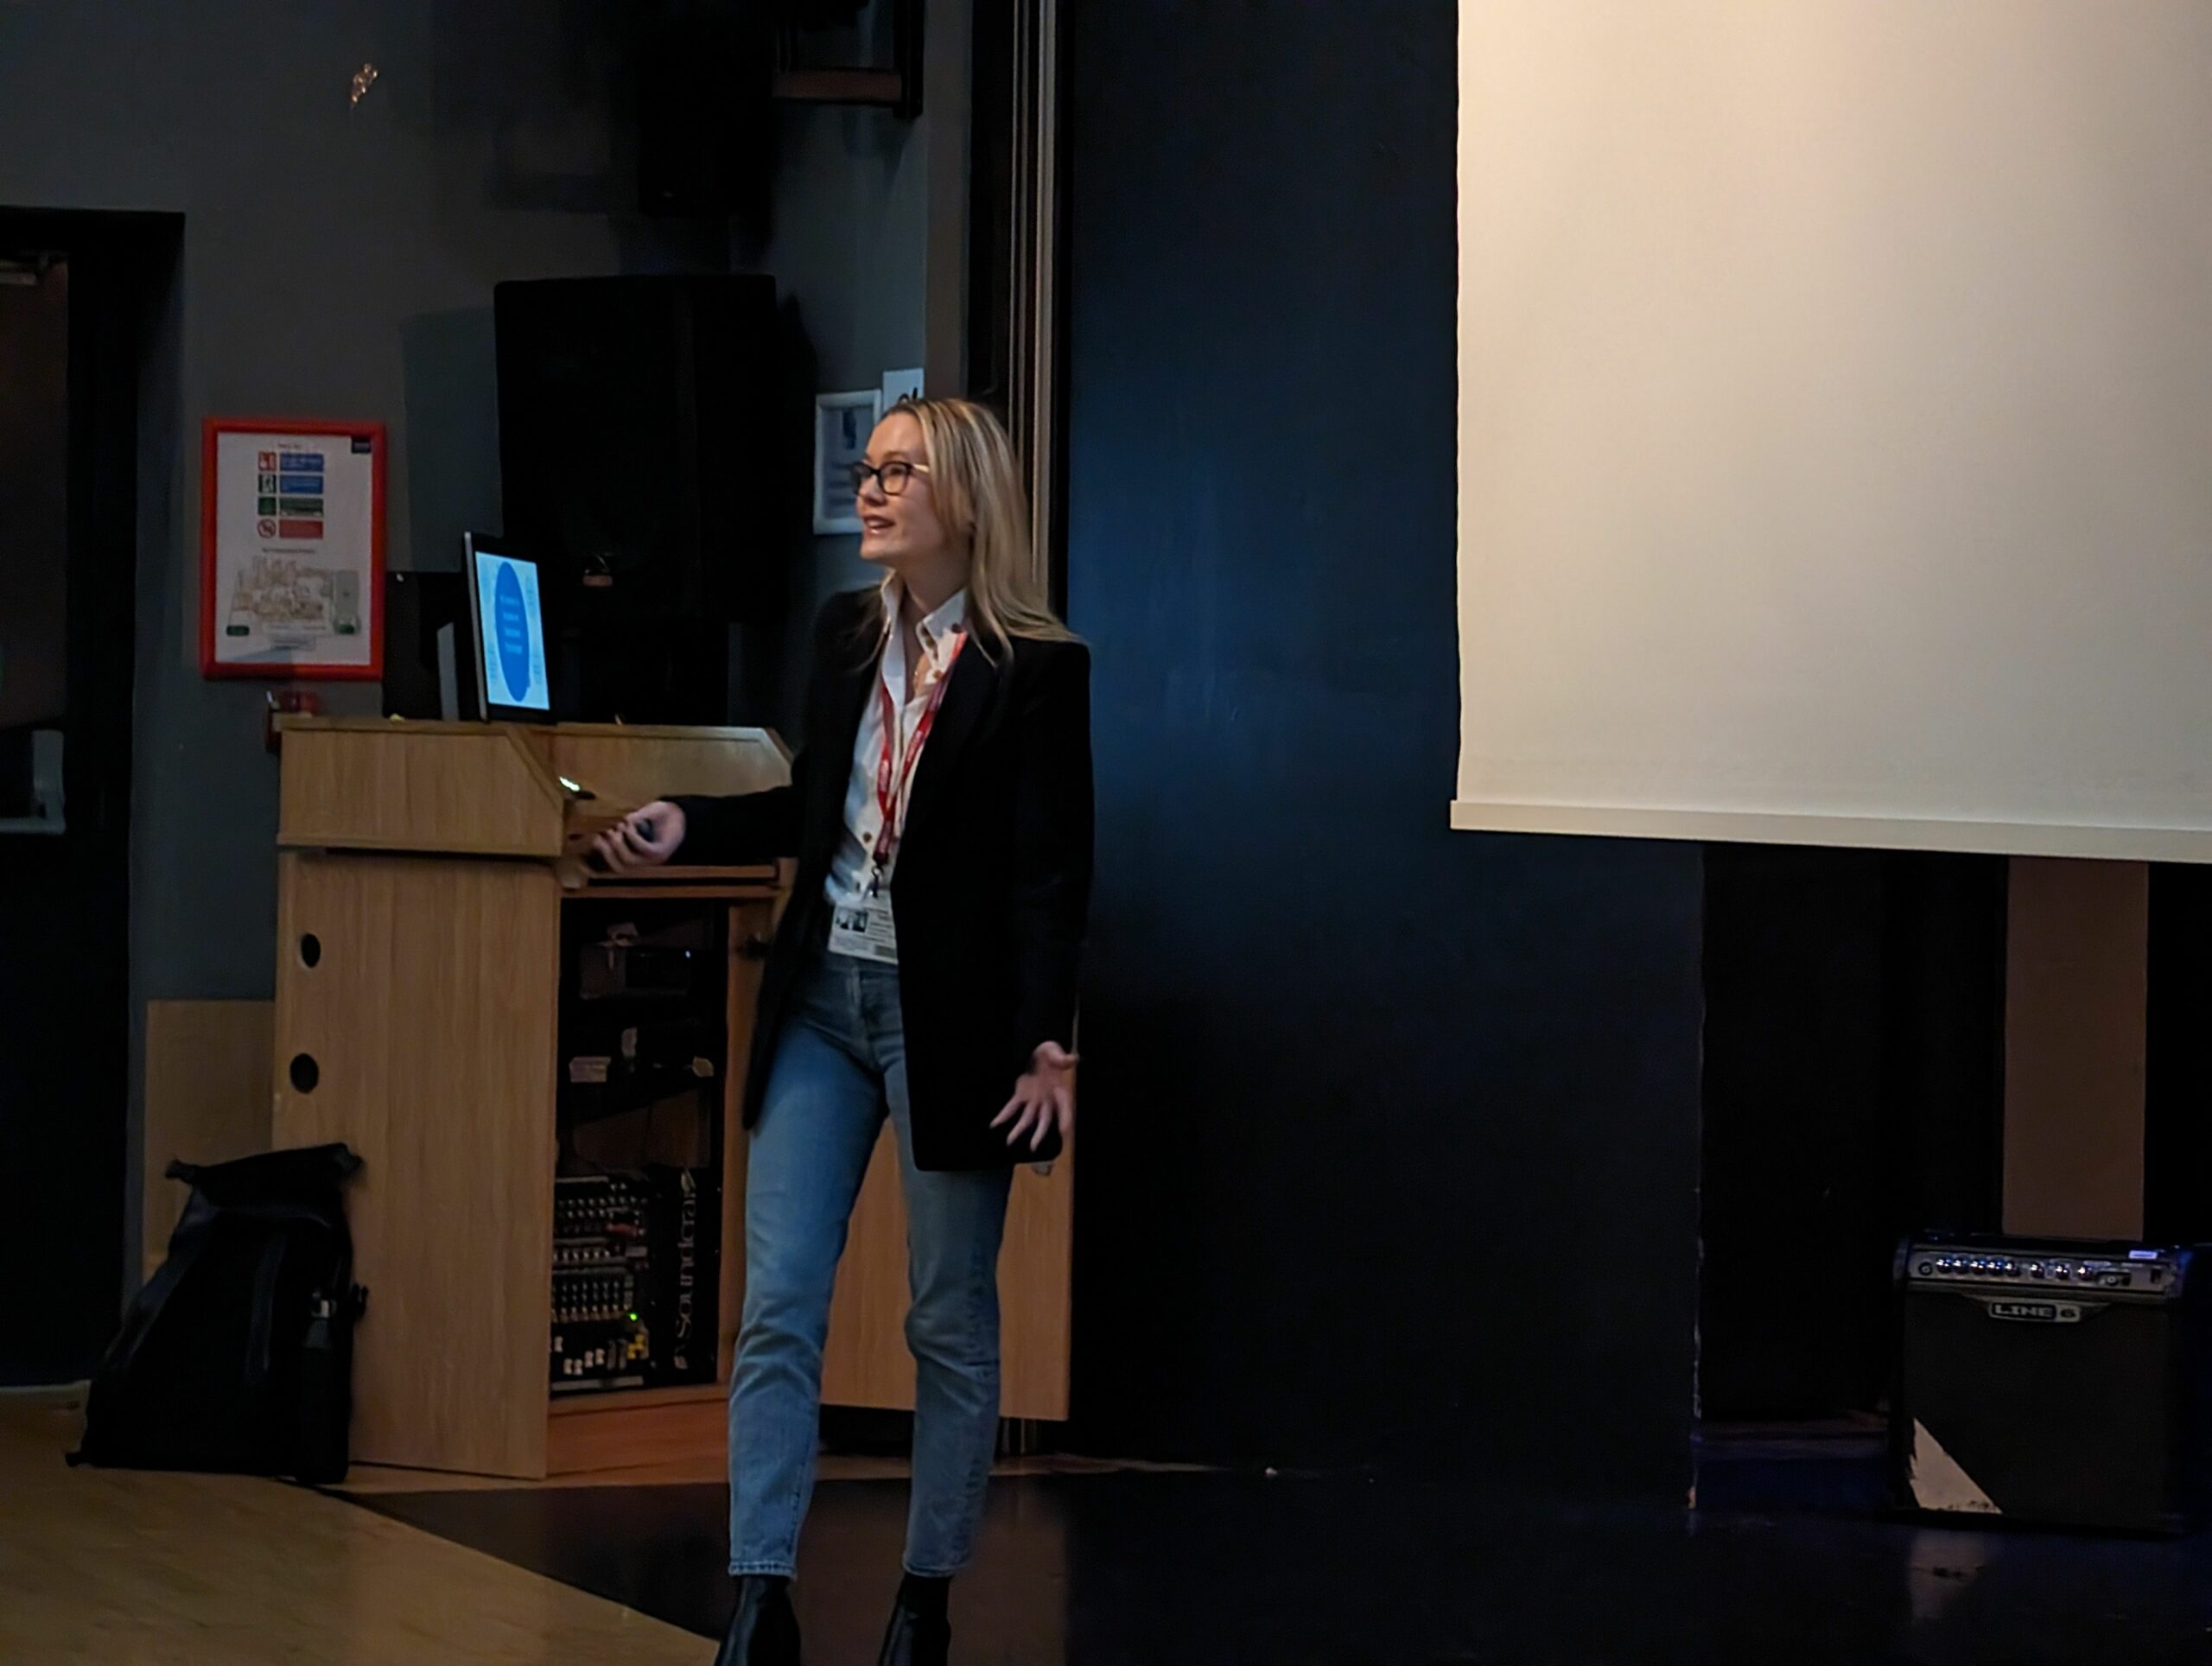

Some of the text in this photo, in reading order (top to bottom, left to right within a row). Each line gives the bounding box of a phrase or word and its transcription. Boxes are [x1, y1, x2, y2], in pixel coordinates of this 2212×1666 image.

[677, 1181, 696, 1339] Soundcraf
[1993, 1303, 2076, 1319] LINE 6
